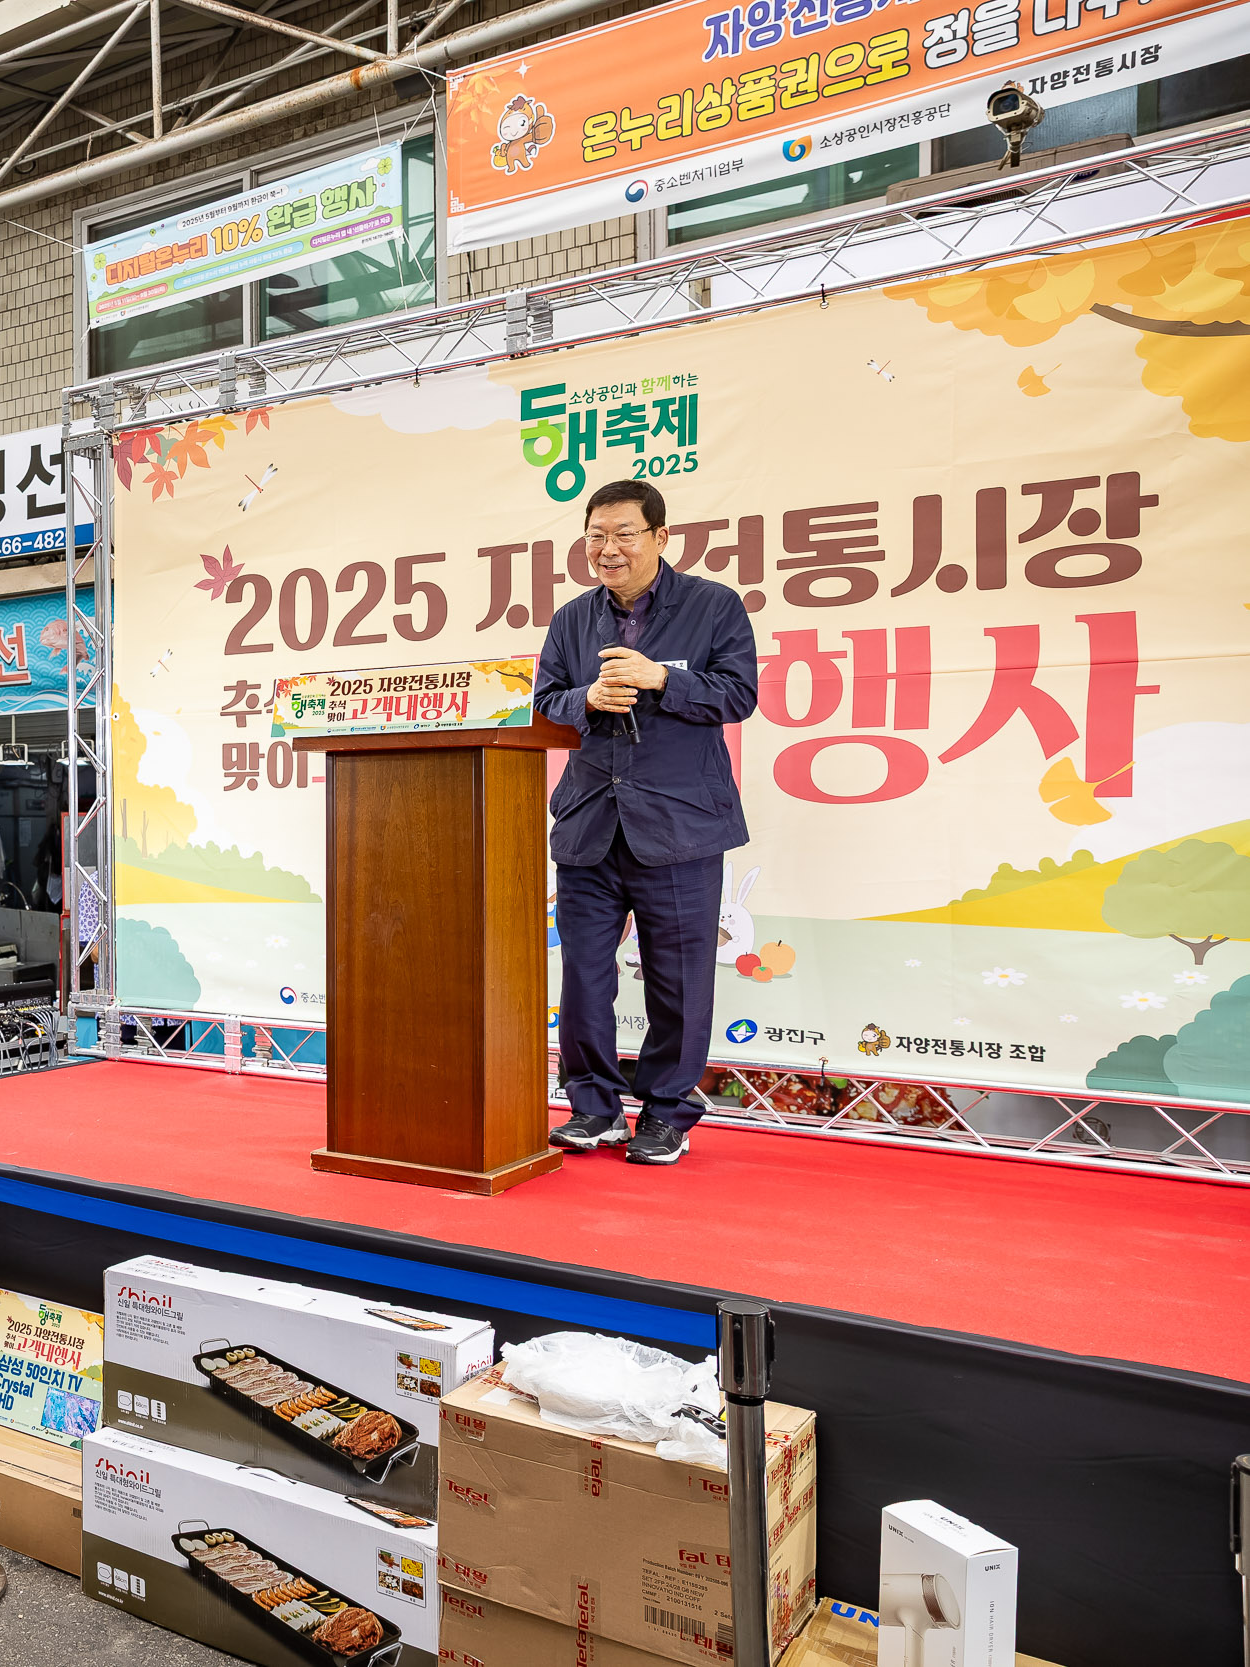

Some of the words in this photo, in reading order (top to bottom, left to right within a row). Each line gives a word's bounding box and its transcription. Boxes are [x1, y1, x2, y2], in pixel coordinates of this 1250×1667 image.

[582, 29, 910, 163] 온누리상품권으로
[923, 0, 1021, 69] 정을
[1028, 44, 1162, 96] 자양전통시장
[819, 103, 951, 150] 소상공인시장진흥공단
[654, 157, 744, 193] 중소벤처기업부
[105, 234, 208, 287] 디지털온누리
[210, 213, 264, 255] 10%
[266, 195, 317, 238] 환급
[320, 176, 377, 220] 행사
[181, 213, 203, 228] 2025년
[569, 383, 637, 406] 소상공인과
[641, 373, 699, 395] 함께하는
[632, 450, 699, 480] 2025
[223, 551, 447, 656] 2025
[329, 677, 374, 697] 2025
[378, 671, 473, 693] 자양전통시장
[220, 680, 275, 728] 추
[327, 711, 346, 722] 맞이
[329, 700, 347, 710] 추석
[346, 691, 471, 722] 고객대행사
[222, 740, 308, 791] 맞이
[764, 1026, 826, 1046] 광진구
[895, 1035, 1003, 1059] 자양전통시장
[1009, 1043, 1046, 1063] 조합
[117, 1298, 131, 1308] 신일
[132, 1301, 184, 1322] 특대형와이드그릴
[7, 1320, 33, 1337] 2025
[33, 1326, 85, 1350] 자양전통시장
[15, 1336, 82, 1370] 고객대행사
[25, 1362, 65, 1389] 50인치
[68, 1373, 83, 1392] TV
[95, 1469, 108, 1481] 신일
[110, 1473, 162, 1499] 특대형와이드그릴
[446, 1479, 491, 1506] Tefal
[888, 1524, 904, 1538] UNIX
[641, 1575, 652, 1584] SET
[984, 1563, 1001, 1572] UNIX
[442, 1590, 485, 1618] Tefal
[577, 1582, 589, 1630] Tefal
